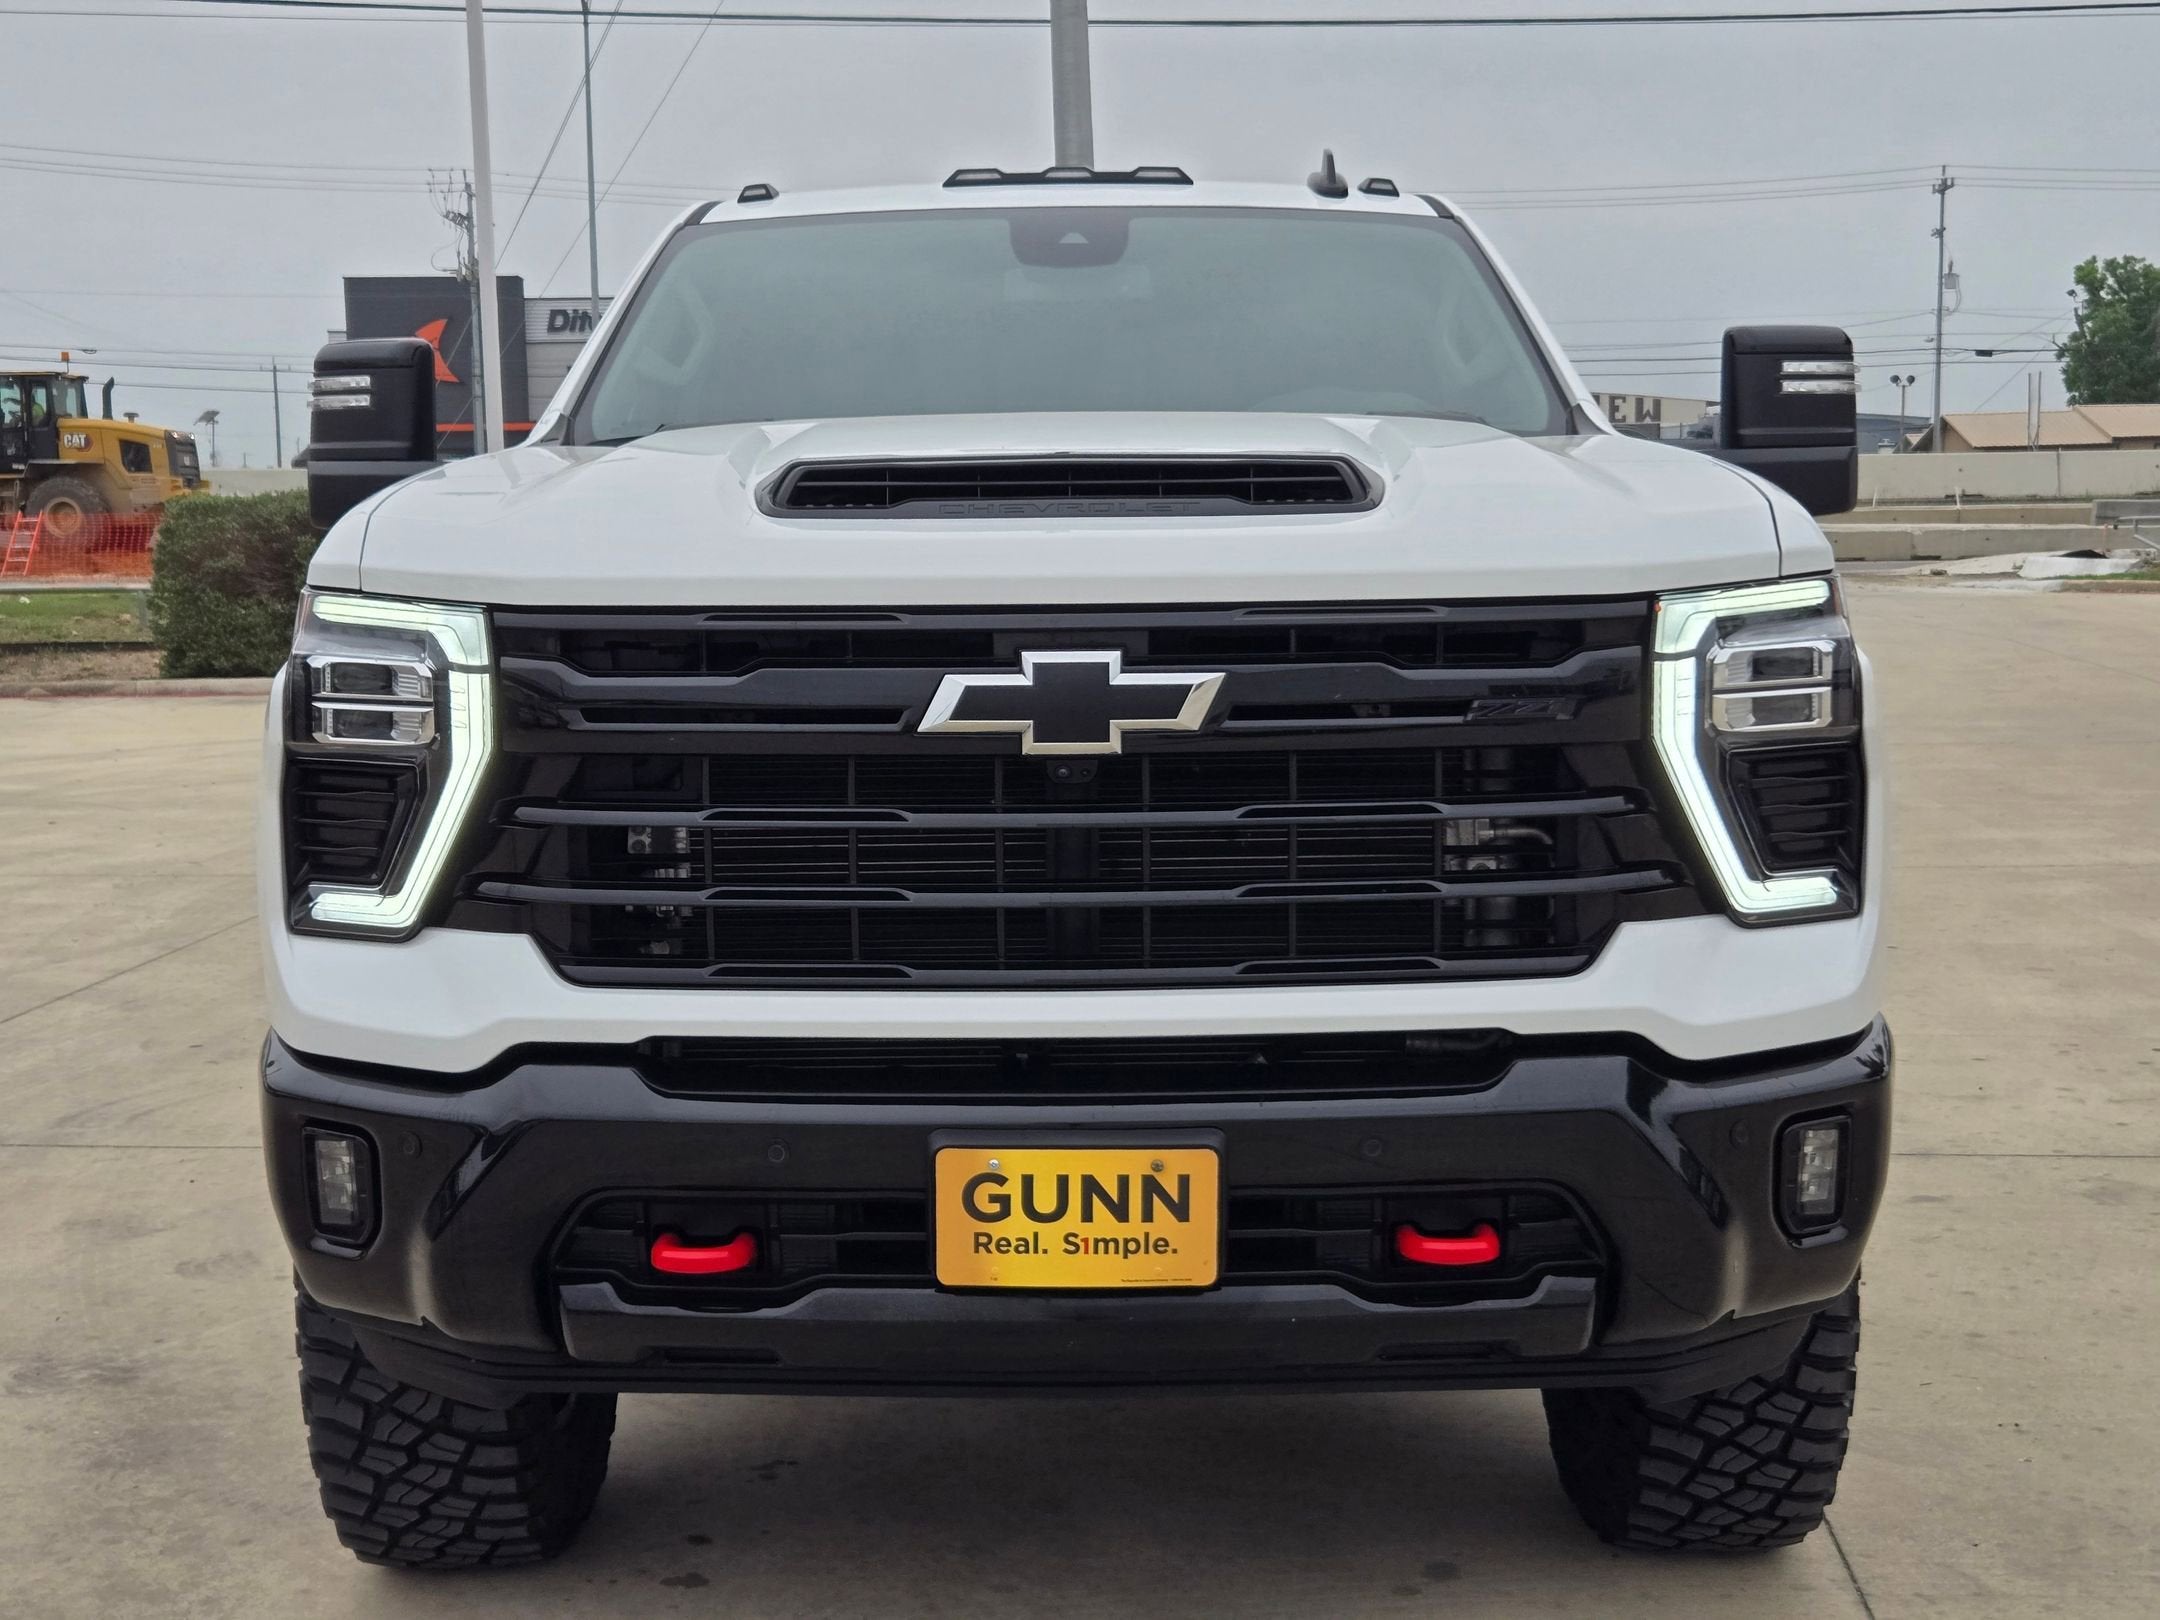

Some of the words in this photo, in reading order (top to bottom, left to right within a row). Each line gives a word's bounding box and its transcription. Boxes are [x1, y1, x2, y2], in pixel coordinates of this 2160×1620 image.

[1592, 395, 1661, 422] EW
[63, 434, 87, 448] CAT
[938, 502, 1201, 515] CHEVROLET
[961, 1172, 1190, 1223] GUNN
[973, 1231, 1048, 1255] Real.
[1062, 1231, 1178, 1259] S1mple.
